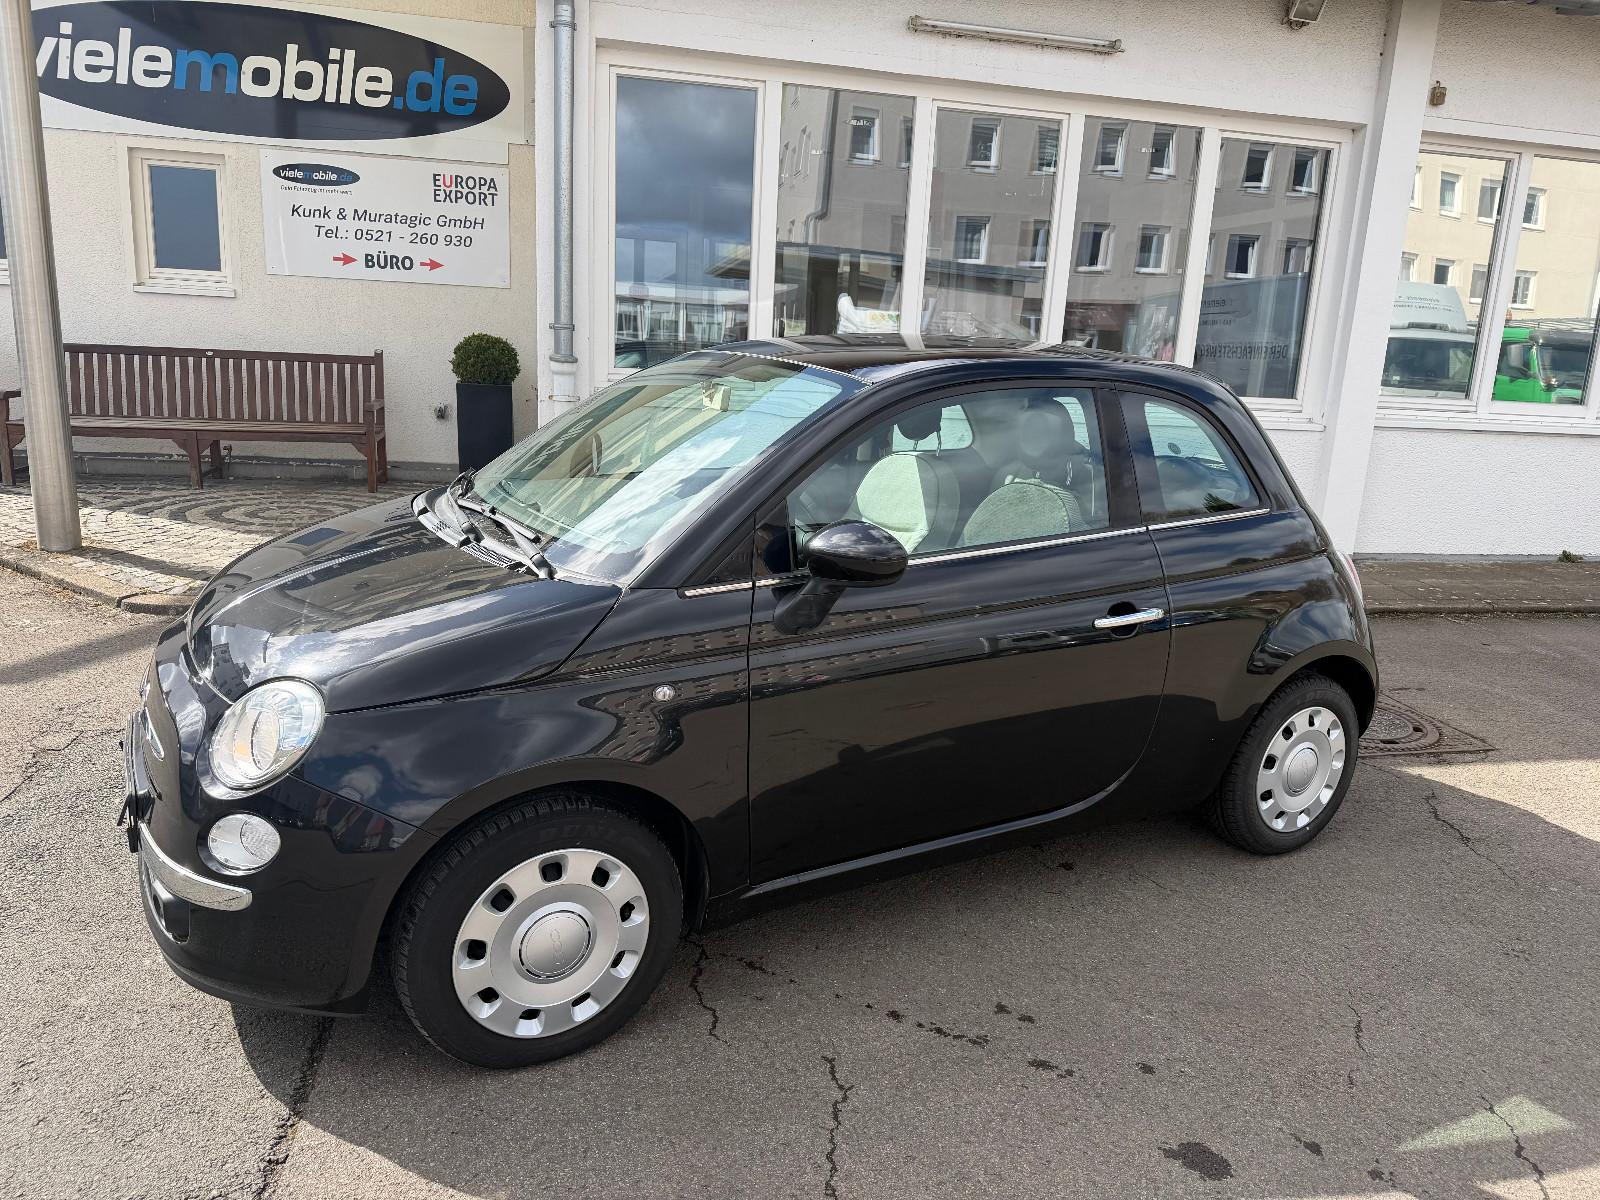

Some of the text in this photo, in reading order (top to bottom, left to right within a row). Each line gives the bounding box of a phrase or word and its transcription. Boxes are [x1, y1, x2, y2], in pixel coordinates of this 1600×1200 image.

[432, 173, 499, 193] EUROPA
[432, 189, 499, 207] EXPORT
[290, 204, 485, 231] Kunk & Muratagic GmbH
[314, 224, 350, 241] Tel.:
[354, 227, 393, 243] 0521
[408, 231, 439, 246] 260
[443, 235, 473, 248] 930
[364, 250, 414, 271] BÜRO
